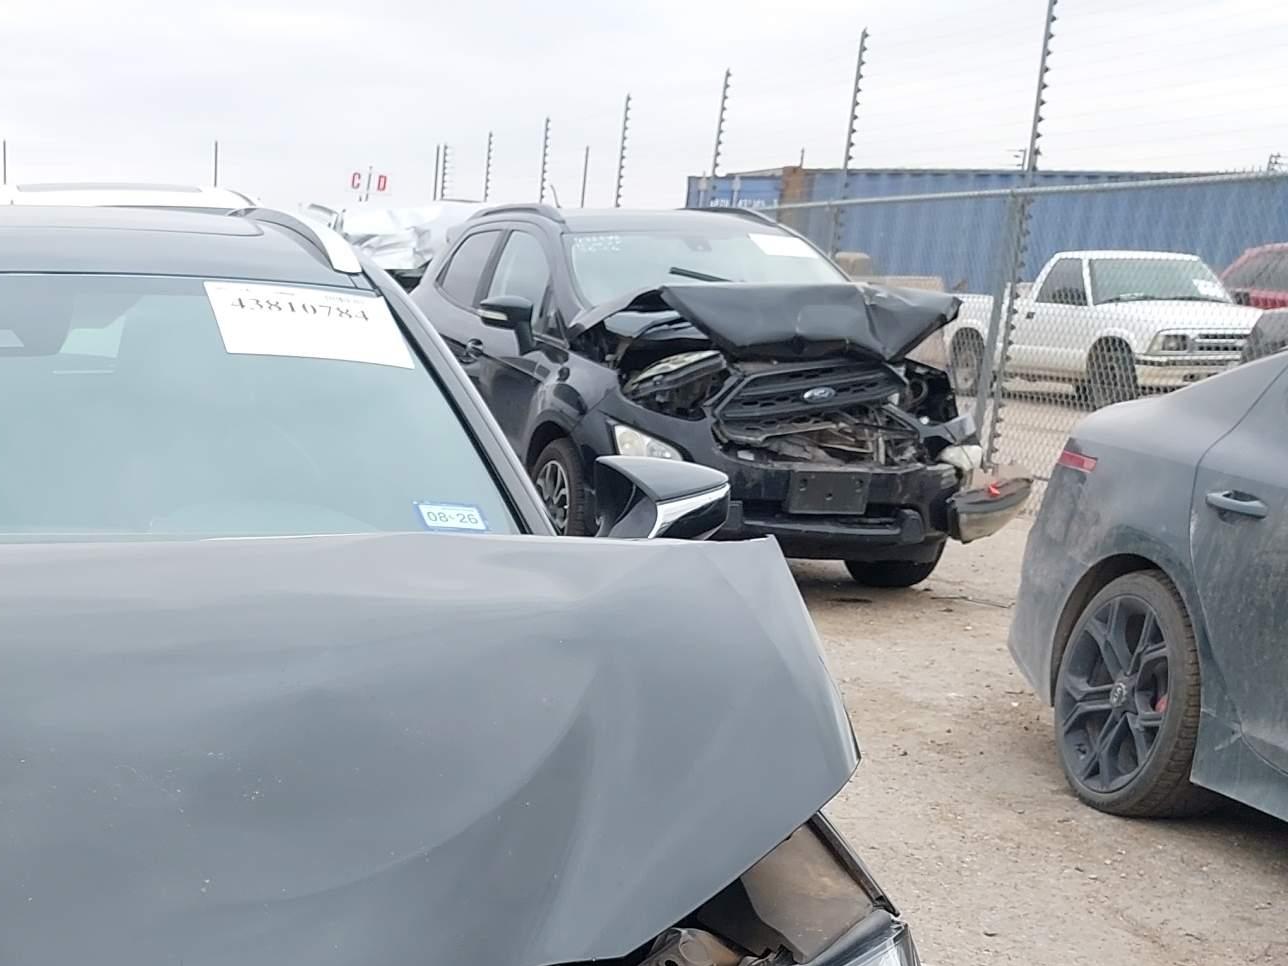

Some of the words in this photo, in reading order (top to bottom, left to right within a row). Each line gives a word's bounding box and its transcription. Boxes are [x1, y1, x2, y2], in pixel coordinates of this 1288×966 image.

[351, 171, 361, 190] C
[377, 174, 388, 192] D
[231, 297, 369, 322] 43810784
